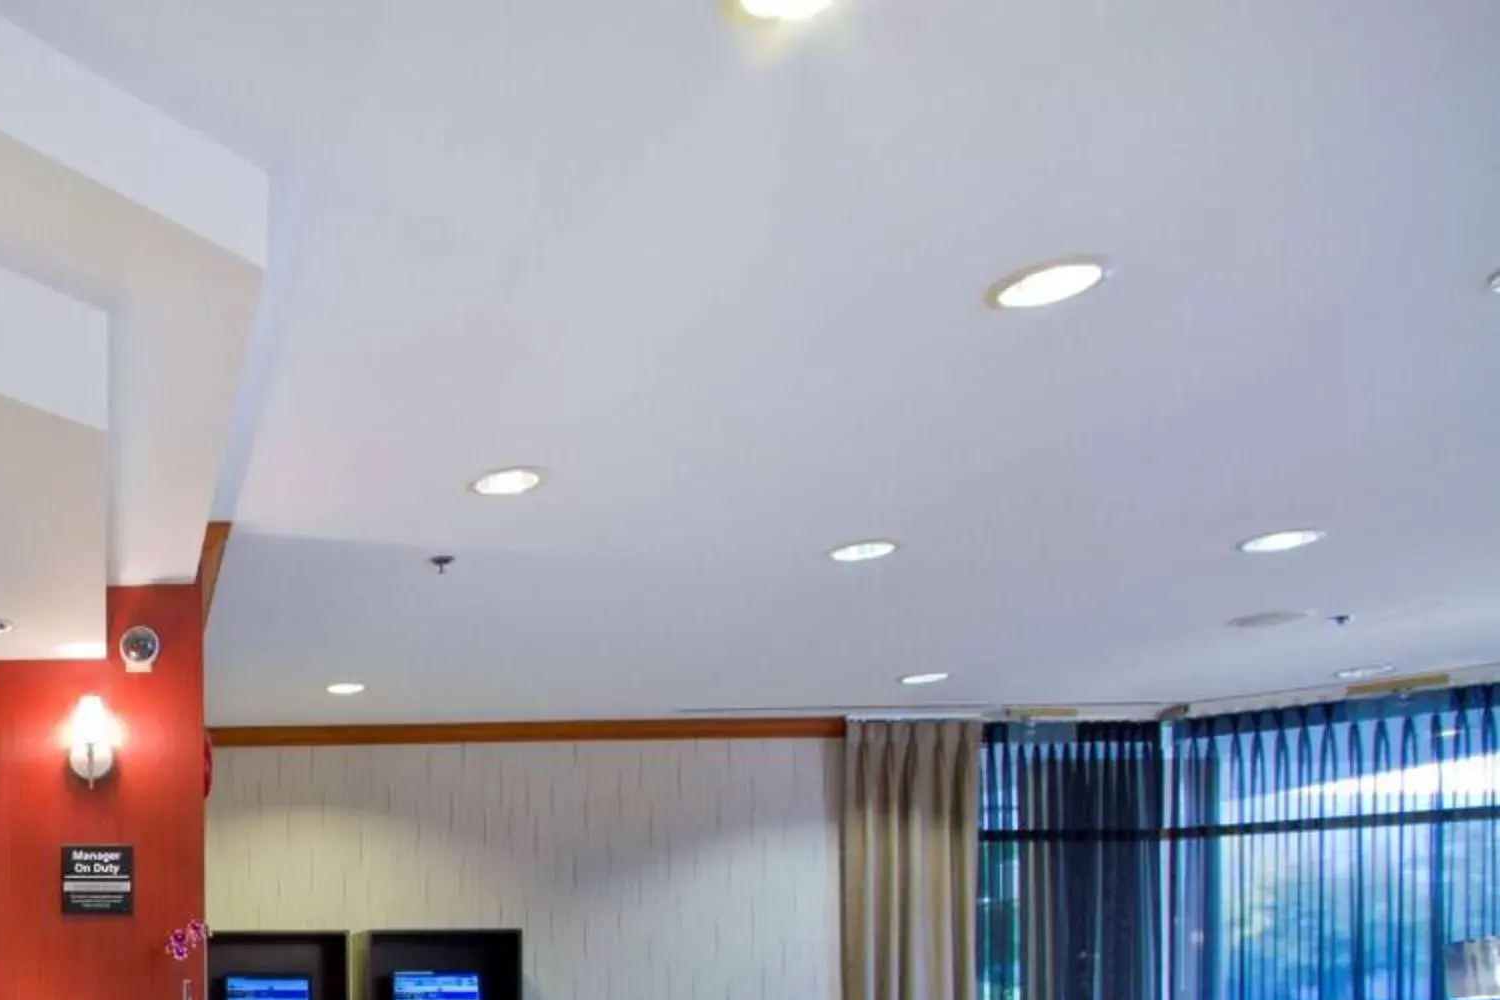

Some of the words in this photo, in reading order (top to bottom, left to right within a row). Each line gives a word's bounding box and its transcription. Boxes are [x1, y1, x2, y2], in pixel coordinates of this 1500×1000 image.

[71, 850, 121, 862] Manager
[74, 863, 91, 873] On
[93, 863, 120, 876] Duty
